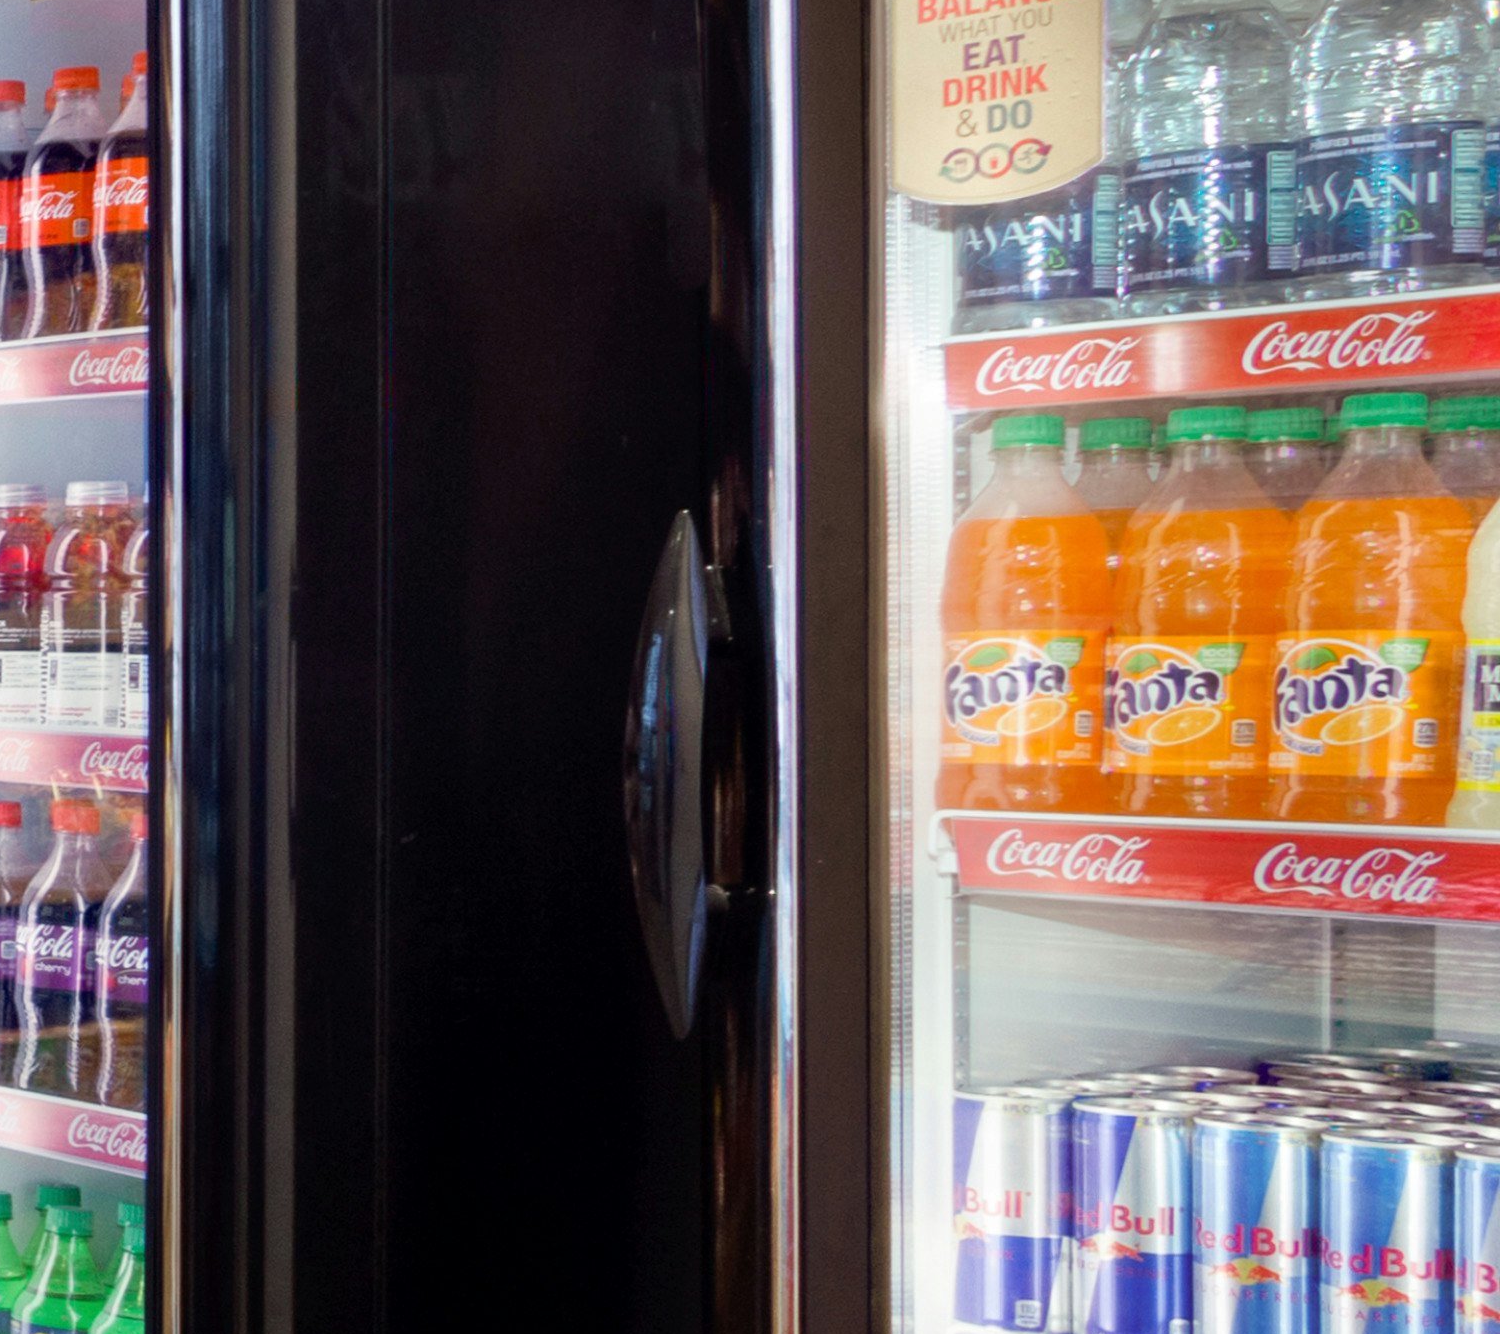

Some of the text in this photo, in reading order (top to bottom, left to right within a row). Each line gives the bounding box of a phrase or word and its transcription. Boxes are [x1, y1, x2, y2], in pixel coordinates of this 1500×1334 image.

[940, 3, 1053, 44] WHAT YOU
[963, 35, 1022, 72] EAT
[943, 63, 1049, 108] DRINK
[955, 100, 1034, 137] & DO
[1127, 187, 1256, 236] ASANI
[1303, 170, 1439, 222] ASANI
[964, 211, 1084, 256] ASANI
[1242, 309, 1437, 376] Coca-Cola
[976, 335, 1141, 396] Coca-Cola
[80, 740, 148, 782] Coca-Col
[986, 828, 1152, 886] Coca-Cola
[1254, 842, 1447, 905] Coca-Cola
[34, 962, 72, 977] cherry
[966, 1185, 1024, 1219] Bull
[1110, 1204, 1175, 1237] Bull
